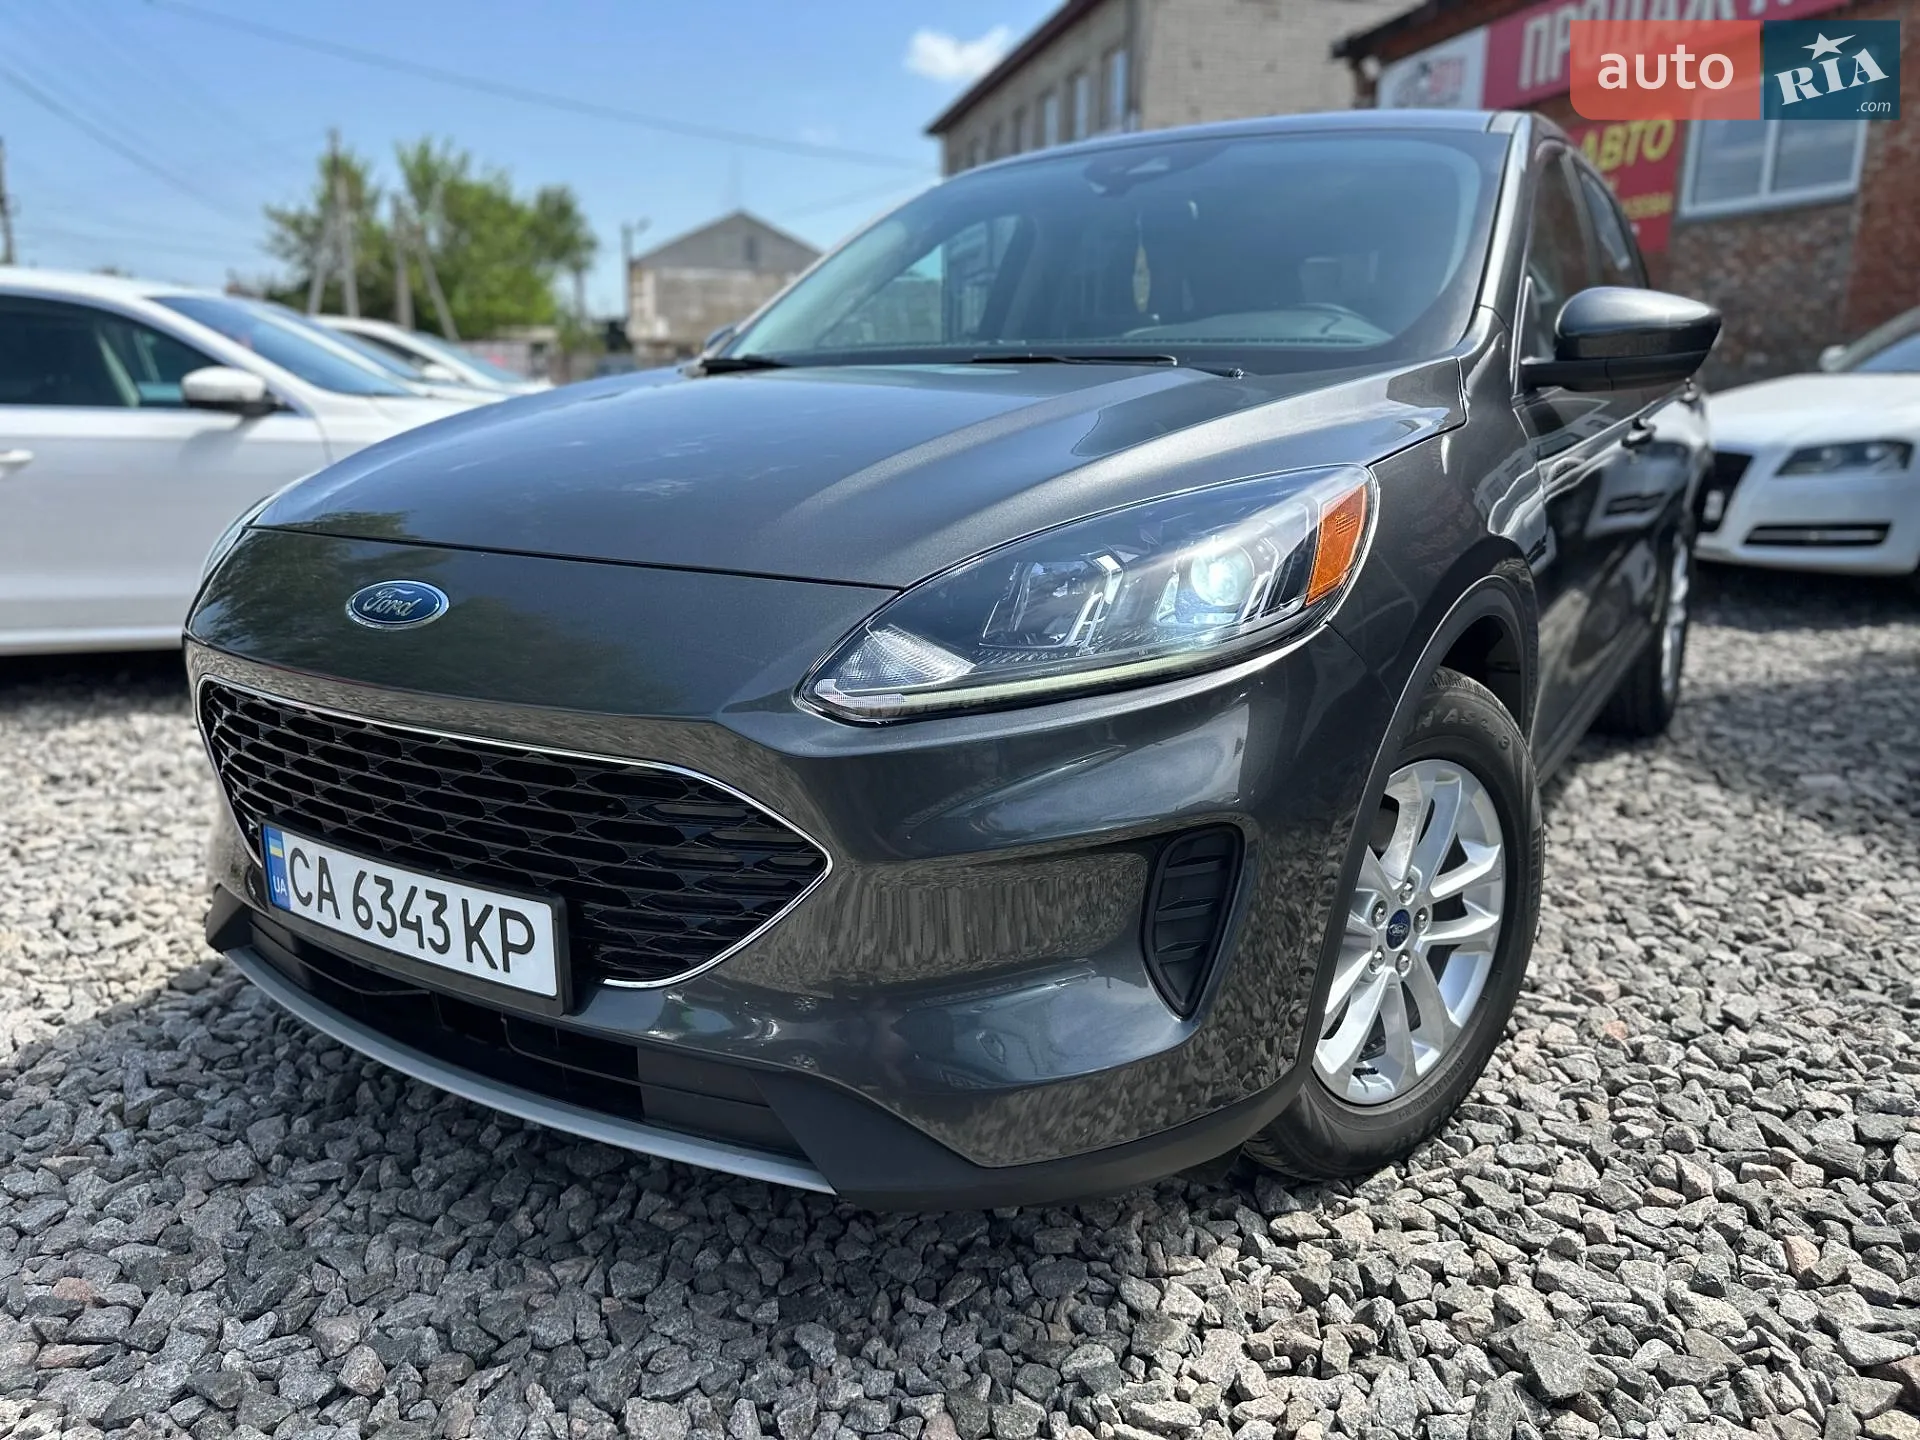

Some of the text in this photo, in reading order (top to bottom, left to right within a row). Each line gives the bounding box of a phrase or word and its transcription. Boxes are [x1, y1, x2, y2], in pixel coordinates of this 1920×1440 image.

[1581, 114, 1675, 171] АВТО
[362, 587, 422, 616] Ford
[273, 875, 288, 897] UA
[289, 848, 536, 973] CA 6343 KP
